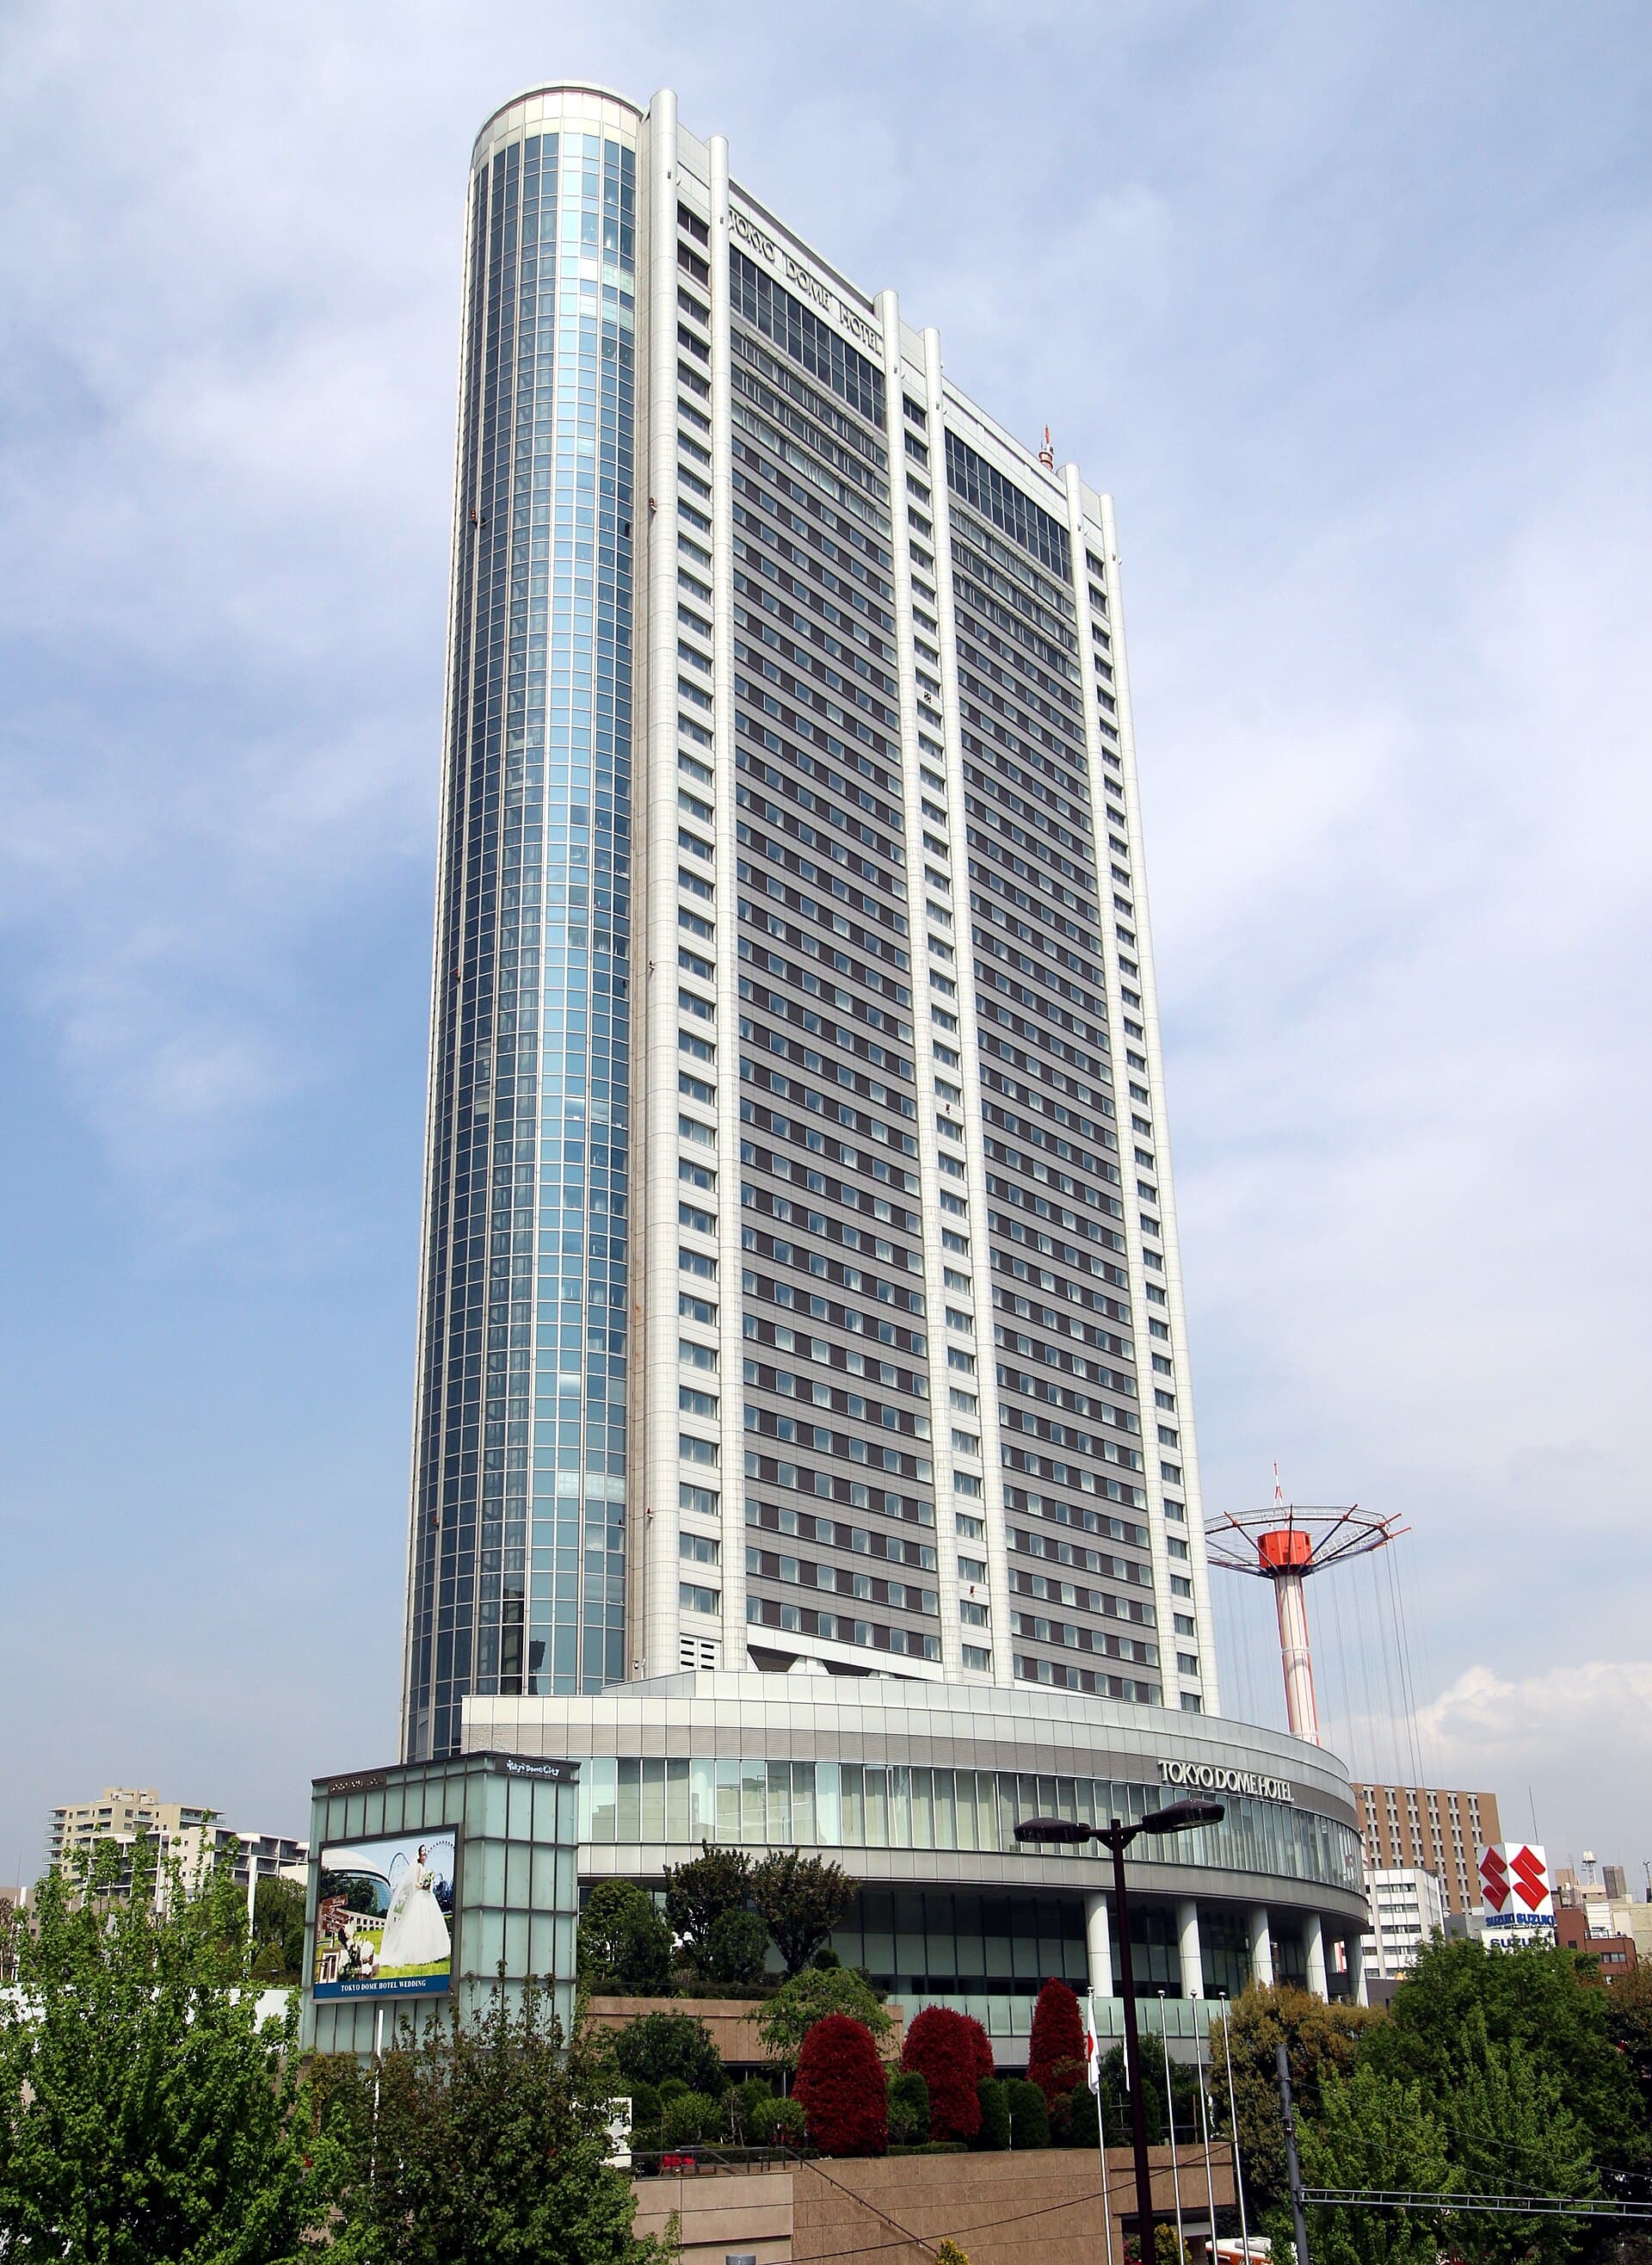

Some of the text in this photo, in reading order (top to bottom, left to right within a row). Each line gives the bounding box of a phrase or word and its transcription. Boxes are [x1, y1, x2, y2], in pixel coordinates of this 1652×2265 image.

[786, 257, 831, 312] DOME
[840, 303, 882, 356] HOTEL
[543, 1765, 560, 1777] City
[1158, 1761, 1295, 1801] TOKYO DOME HOTEL
[1486, 1913, 1515, 1927] SUZUKI
[1516, 1913, 1555, 1925] SUZUKI
[379, 1981, 398, 1990] HOTEL
[399, 1979, 427, 1988] WEDDING
